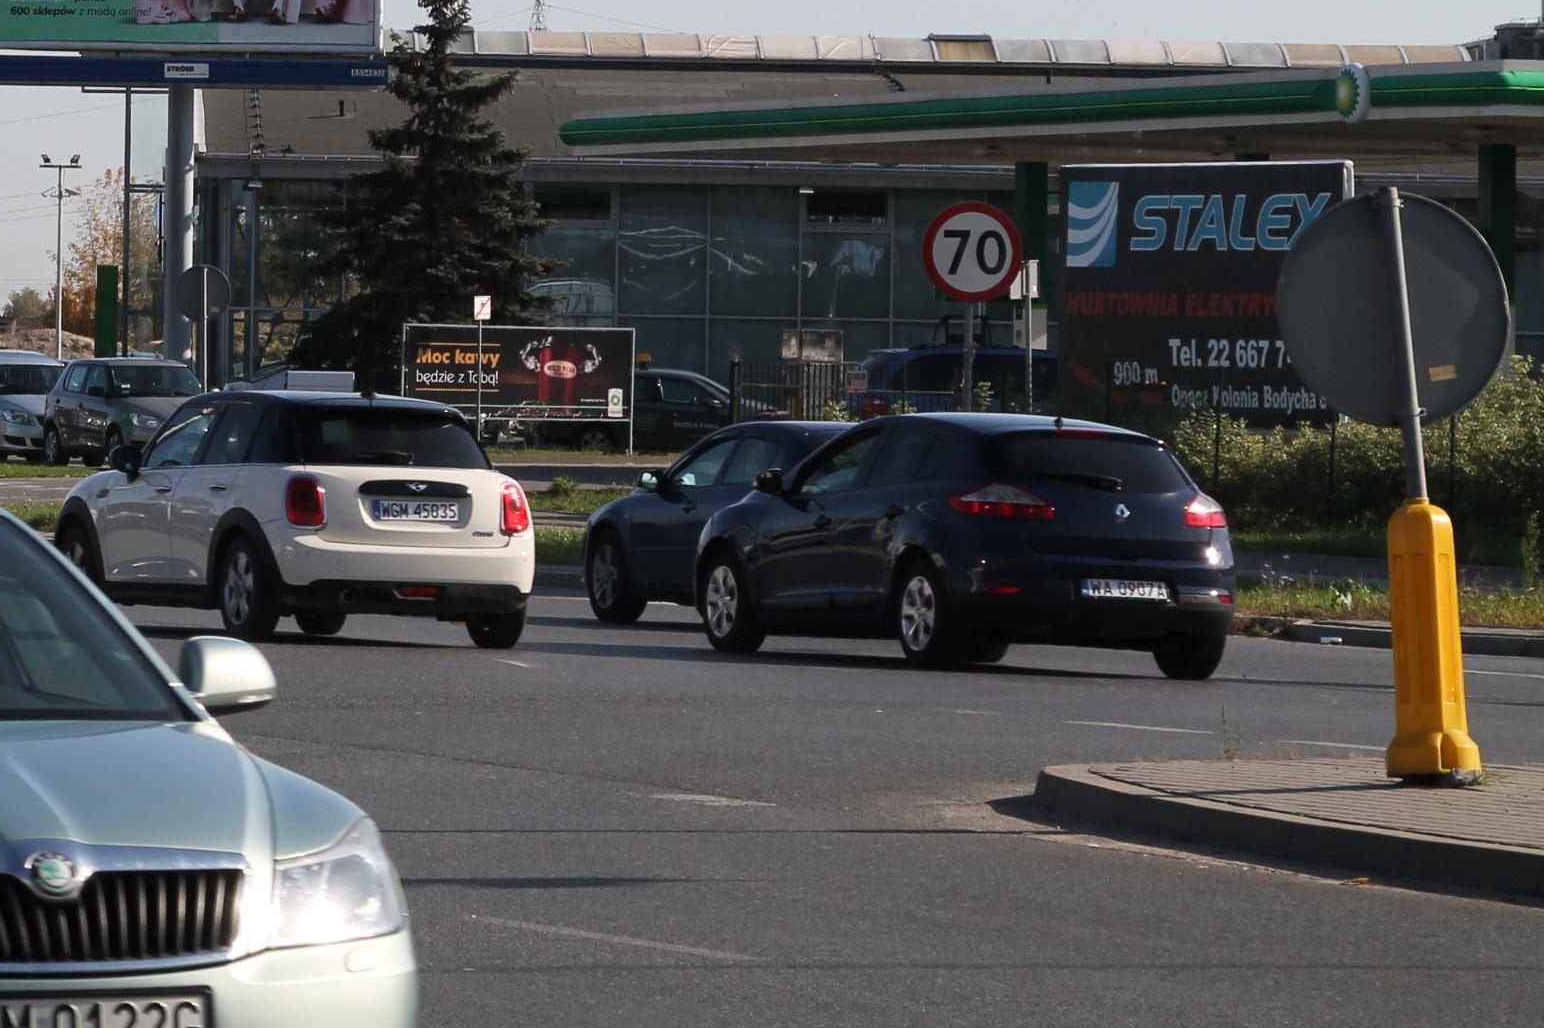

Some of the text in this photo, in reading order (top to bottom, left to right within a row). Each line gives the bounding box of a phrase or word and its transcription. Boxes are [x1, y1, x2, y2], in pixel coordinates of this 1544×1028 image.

[10, 6, 30, 15] 600
[32, 5, 76, 17] sklepów
[944, 229, 1008, 276] 70
[1065, 292, 1278, 316] HURTOWNIA ELEKTRY
[416, 348, 500, 368] Moc kawy
[1169, 339, 1292, 368] Tel. 22 667 7
[416, 369, 499, 386] będzie z Tobą!
[1114, 362, 1158, 385] 900 m
[1264, 385, 1315, 413] Bodycha
[380, 502, 409, 518] WGM
[1090, 581, 1113, 596] WA
